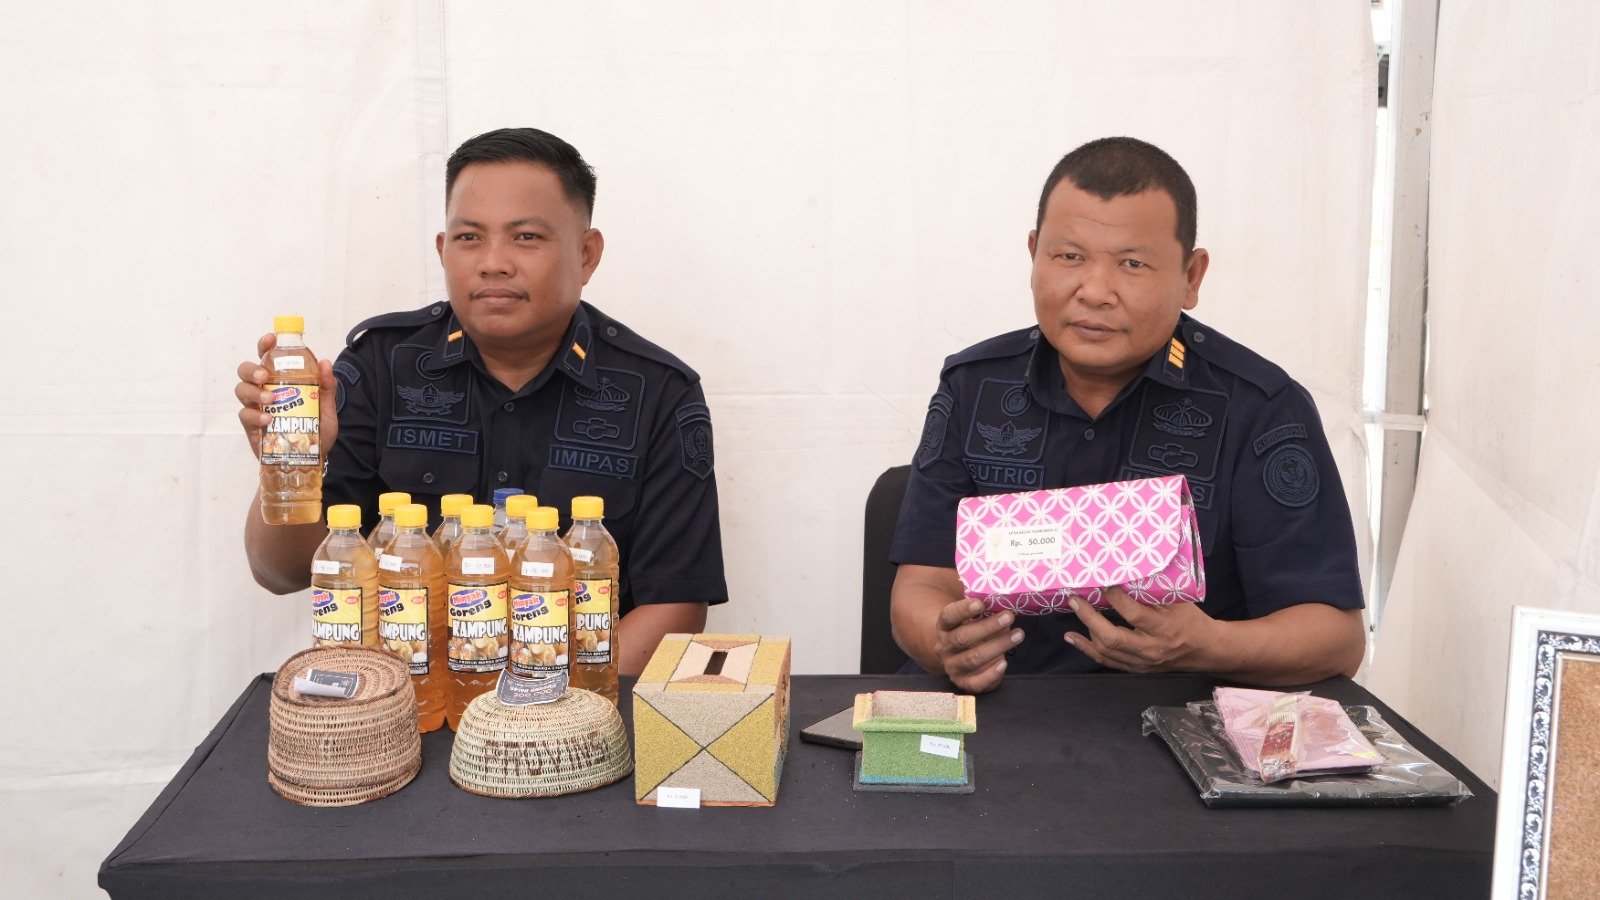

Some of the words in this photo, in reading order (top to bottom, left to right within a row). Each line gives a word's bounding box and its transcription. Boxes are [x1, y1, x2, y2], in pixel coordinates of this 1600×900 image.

[264, 397, 305, 414] Goreng
[396, 429, 469, 449] ISMET
[554, 449, 630, 473] IMIPAS
[968, 463, 1037, 485] SUTRIO
[1010, 539, 1023, 547] Rp.
[1028, 536, 1056, 546] 50.000
[450, 599, 492, 617] Goreng
[313, 621, 360, 641] AMPUNG
[452, 617, 507, 639] KAMPUNG
[576, 612, 610, 631] PUNG
[512, 622, 568, 644] KAMPUNG
